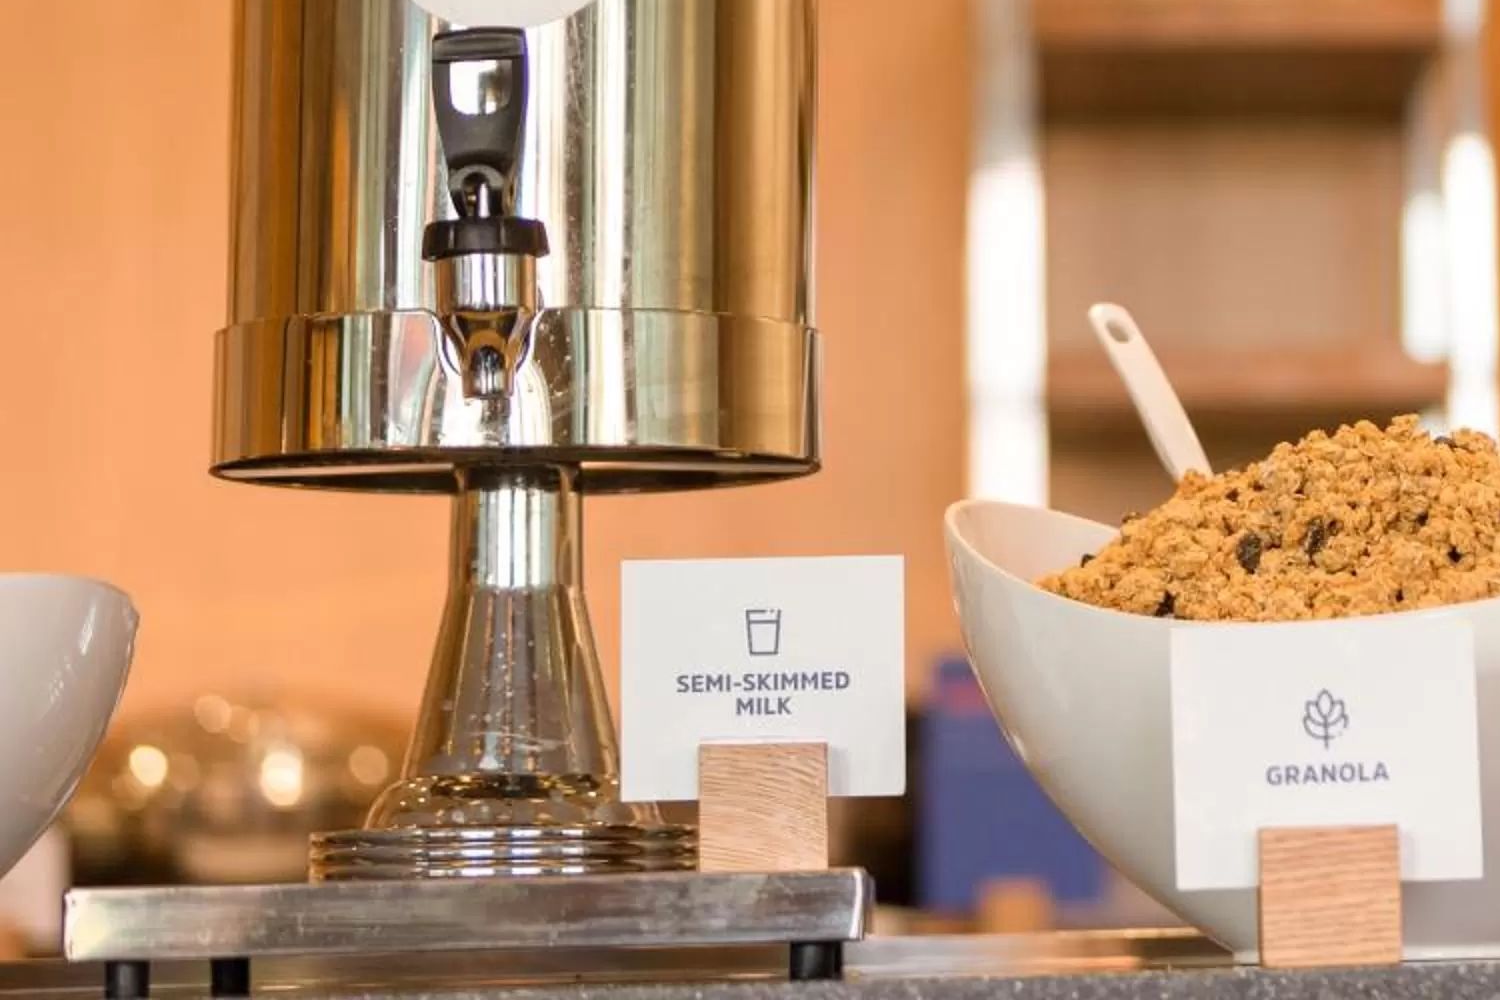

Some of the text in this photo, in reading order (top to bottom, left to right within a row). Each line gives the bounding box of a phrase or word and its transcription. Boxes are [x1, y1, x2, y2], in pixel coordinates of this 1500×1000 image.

[677, 672, 849, 693] SEMI-SKIMMED
[736, 697, 791, 715] MILK
[1266, 762, 1388, 785] GRANOLA
